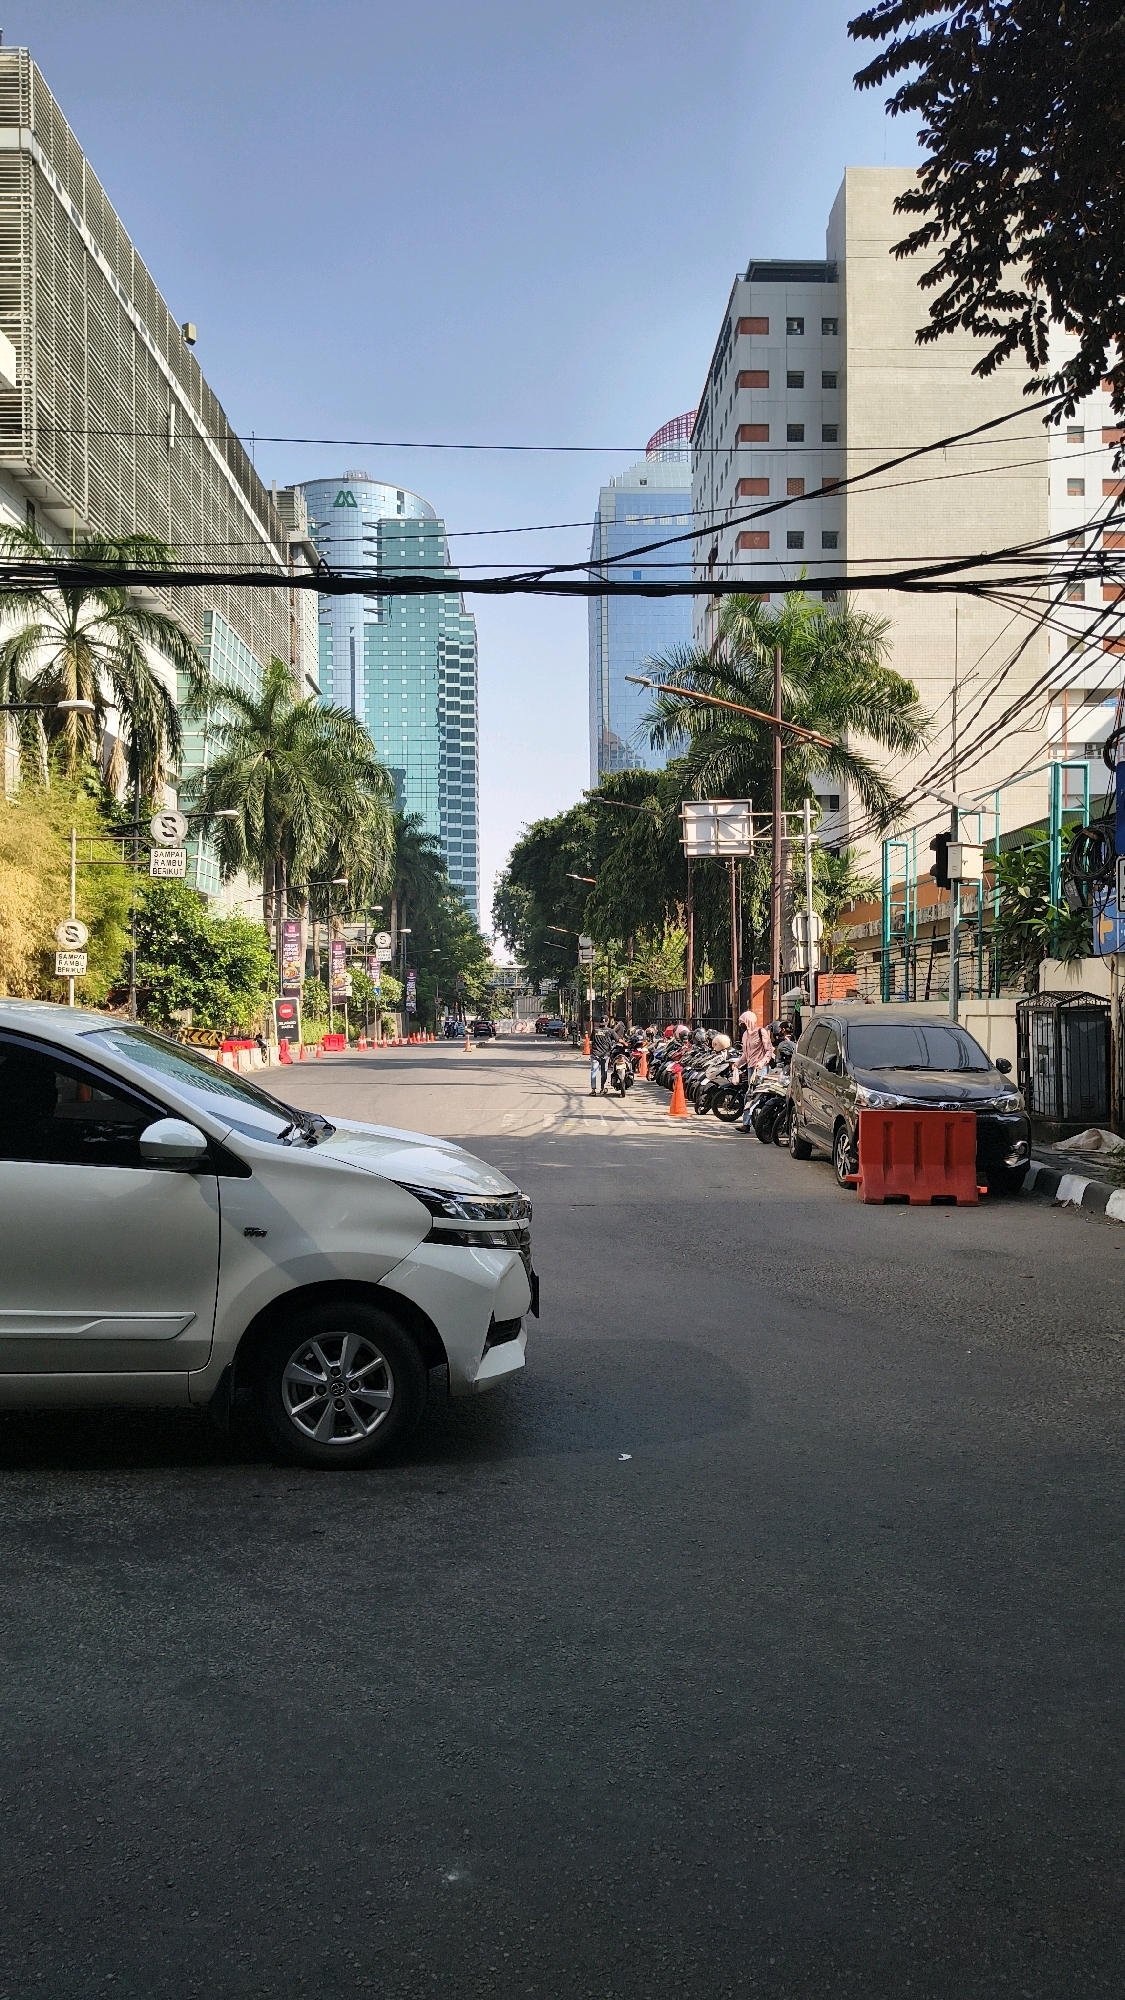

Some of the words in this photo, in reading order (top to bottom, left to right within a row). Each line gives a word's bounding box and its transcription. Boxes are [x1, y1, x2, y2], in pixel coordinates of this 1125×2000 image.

[153, 850, 183, 858] SAMPAI
[153, 859, 183, 867] RAMBU
[152, 867, 183, 876] BERIKUT
